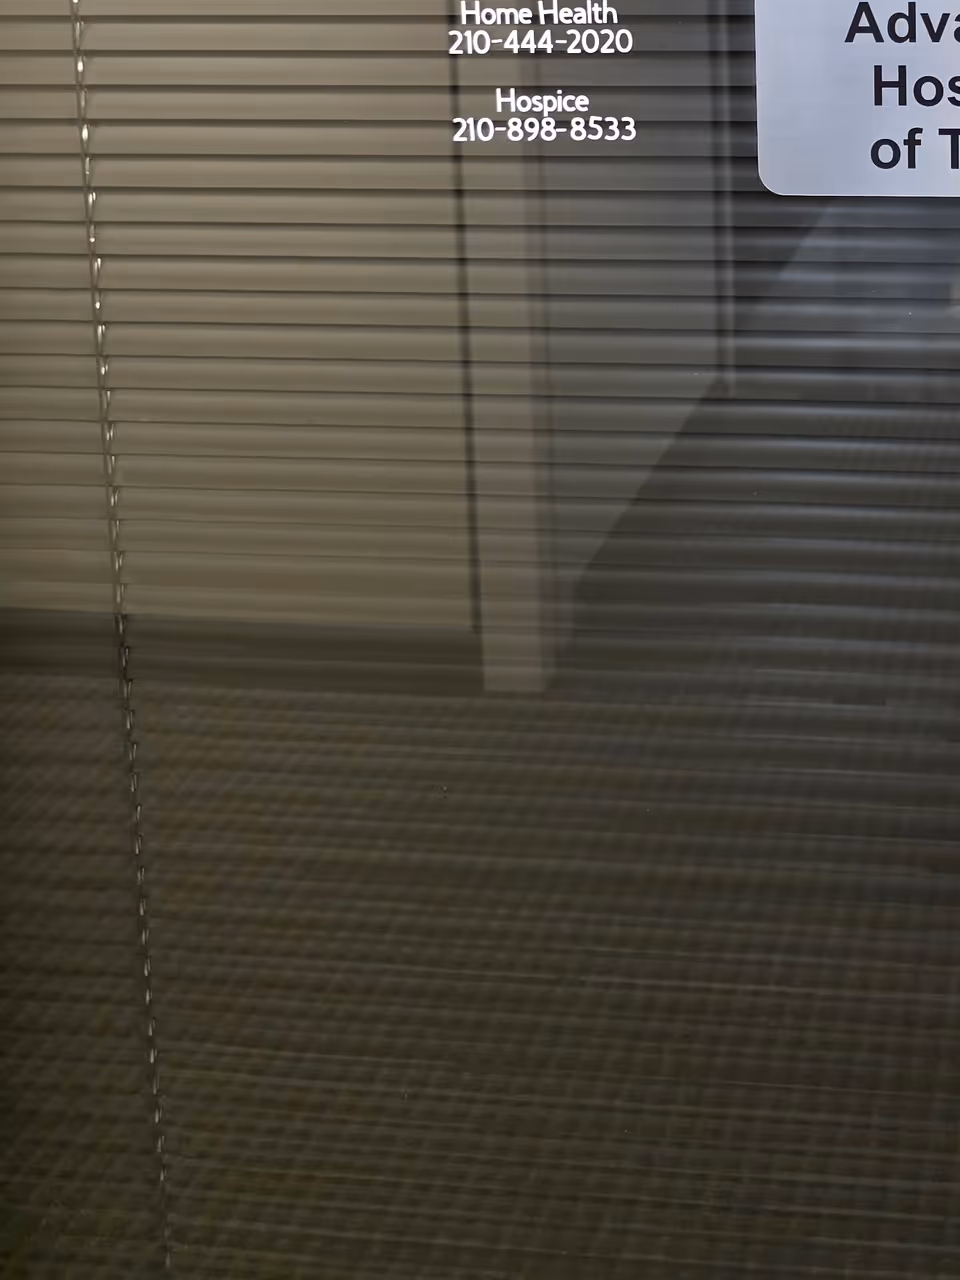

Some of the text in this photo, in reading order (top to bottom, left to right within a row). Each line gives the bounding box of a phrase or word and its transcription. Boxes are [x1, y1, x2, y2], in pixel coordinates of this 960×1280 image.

[460, 0, 618, 25] Home Health
[448, 28, 633, 55] 210-444-2020
[495, 87, 590, 117] Hospice
[452, 115, 637, 142] 210-898-8533
[870, 127, 924, 170] of
